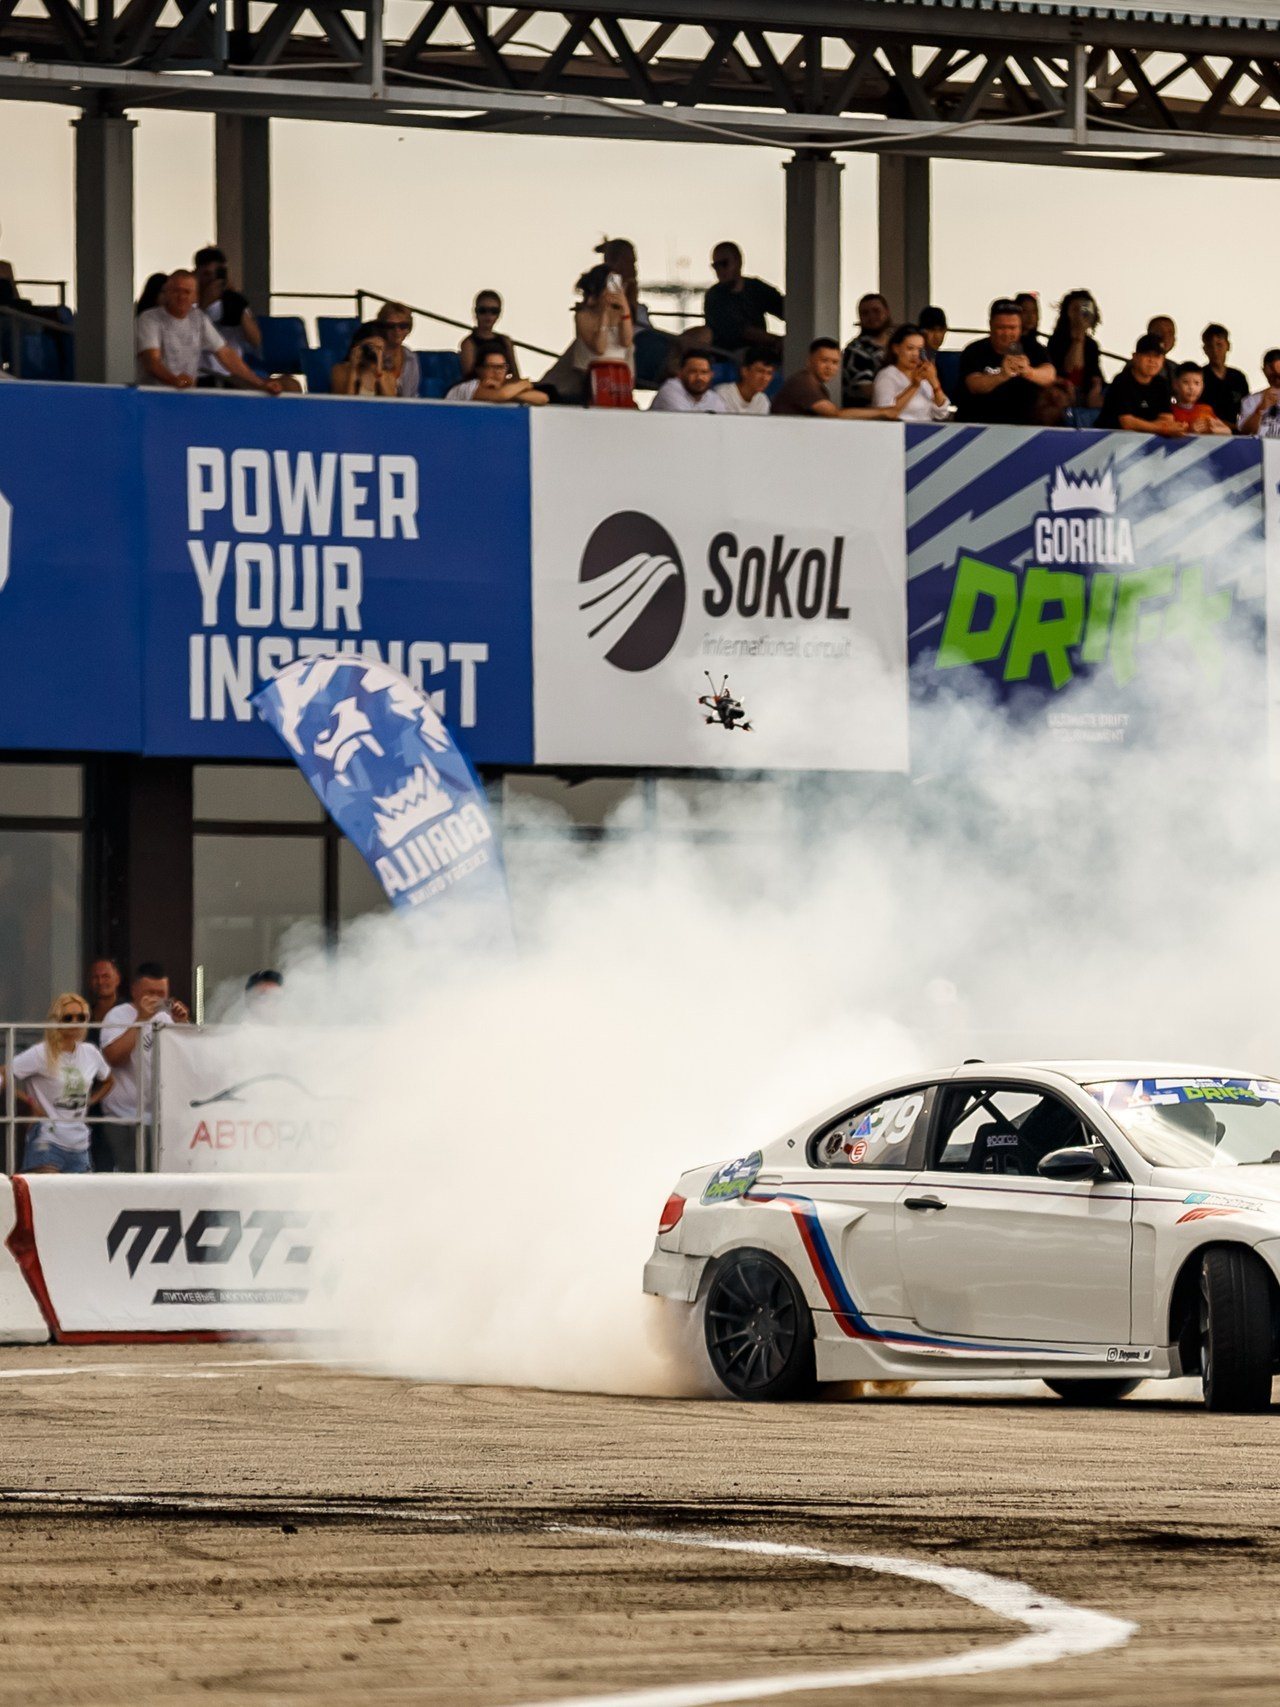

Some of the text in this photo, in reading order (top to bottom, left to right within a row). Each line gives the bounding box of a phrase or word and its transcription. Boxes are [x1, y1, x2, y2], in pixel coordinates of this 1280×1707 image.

[187, 447, 419, 539] POWER
[187, 540, 363, 631] YOUR
[1035, 518, 1135, 564] GORILLA
